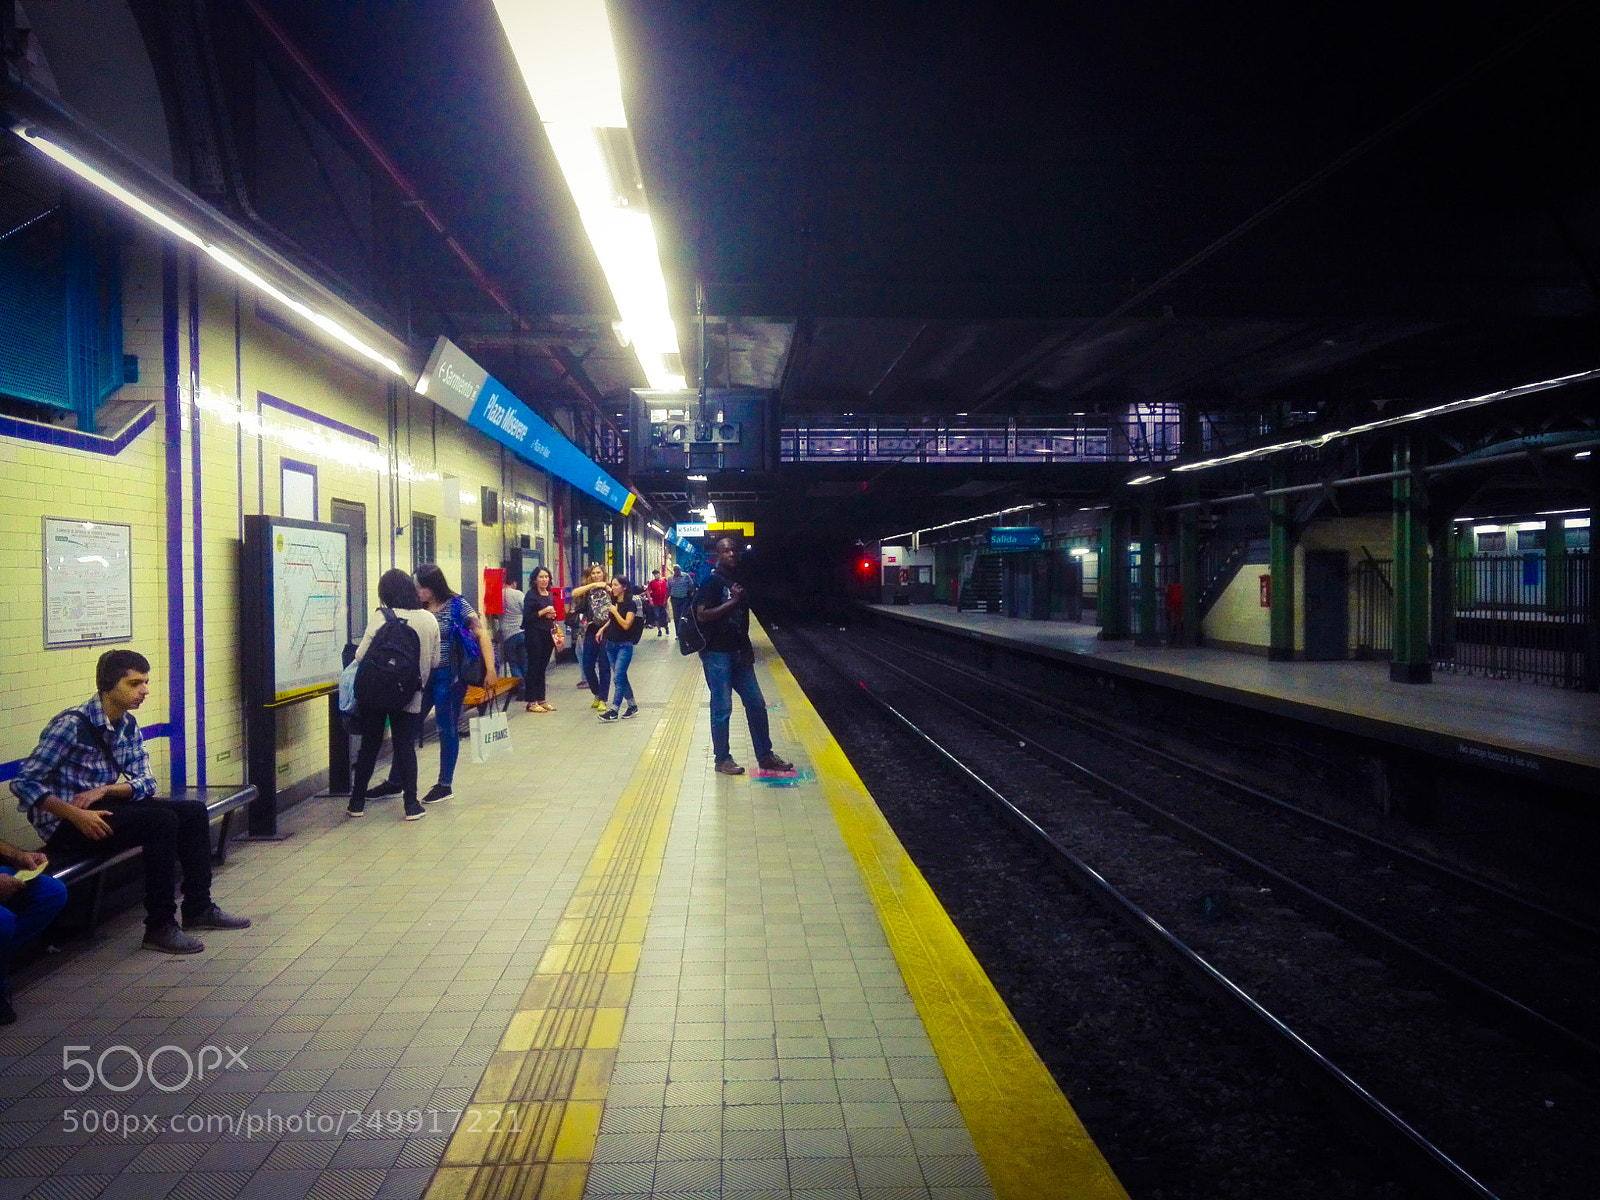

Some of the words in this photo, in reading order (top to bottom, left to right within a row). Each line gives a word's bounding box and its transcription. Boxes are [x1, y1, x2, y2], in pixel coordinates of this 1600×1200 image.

[442, 364, 474, 399] Sarmiento
[483, 393, 506, 426] Plaza
[500, 406, 529, 442] Miserere
[991, 535, 1017, 544] Salida
[484, 733, 491, 744] LE
